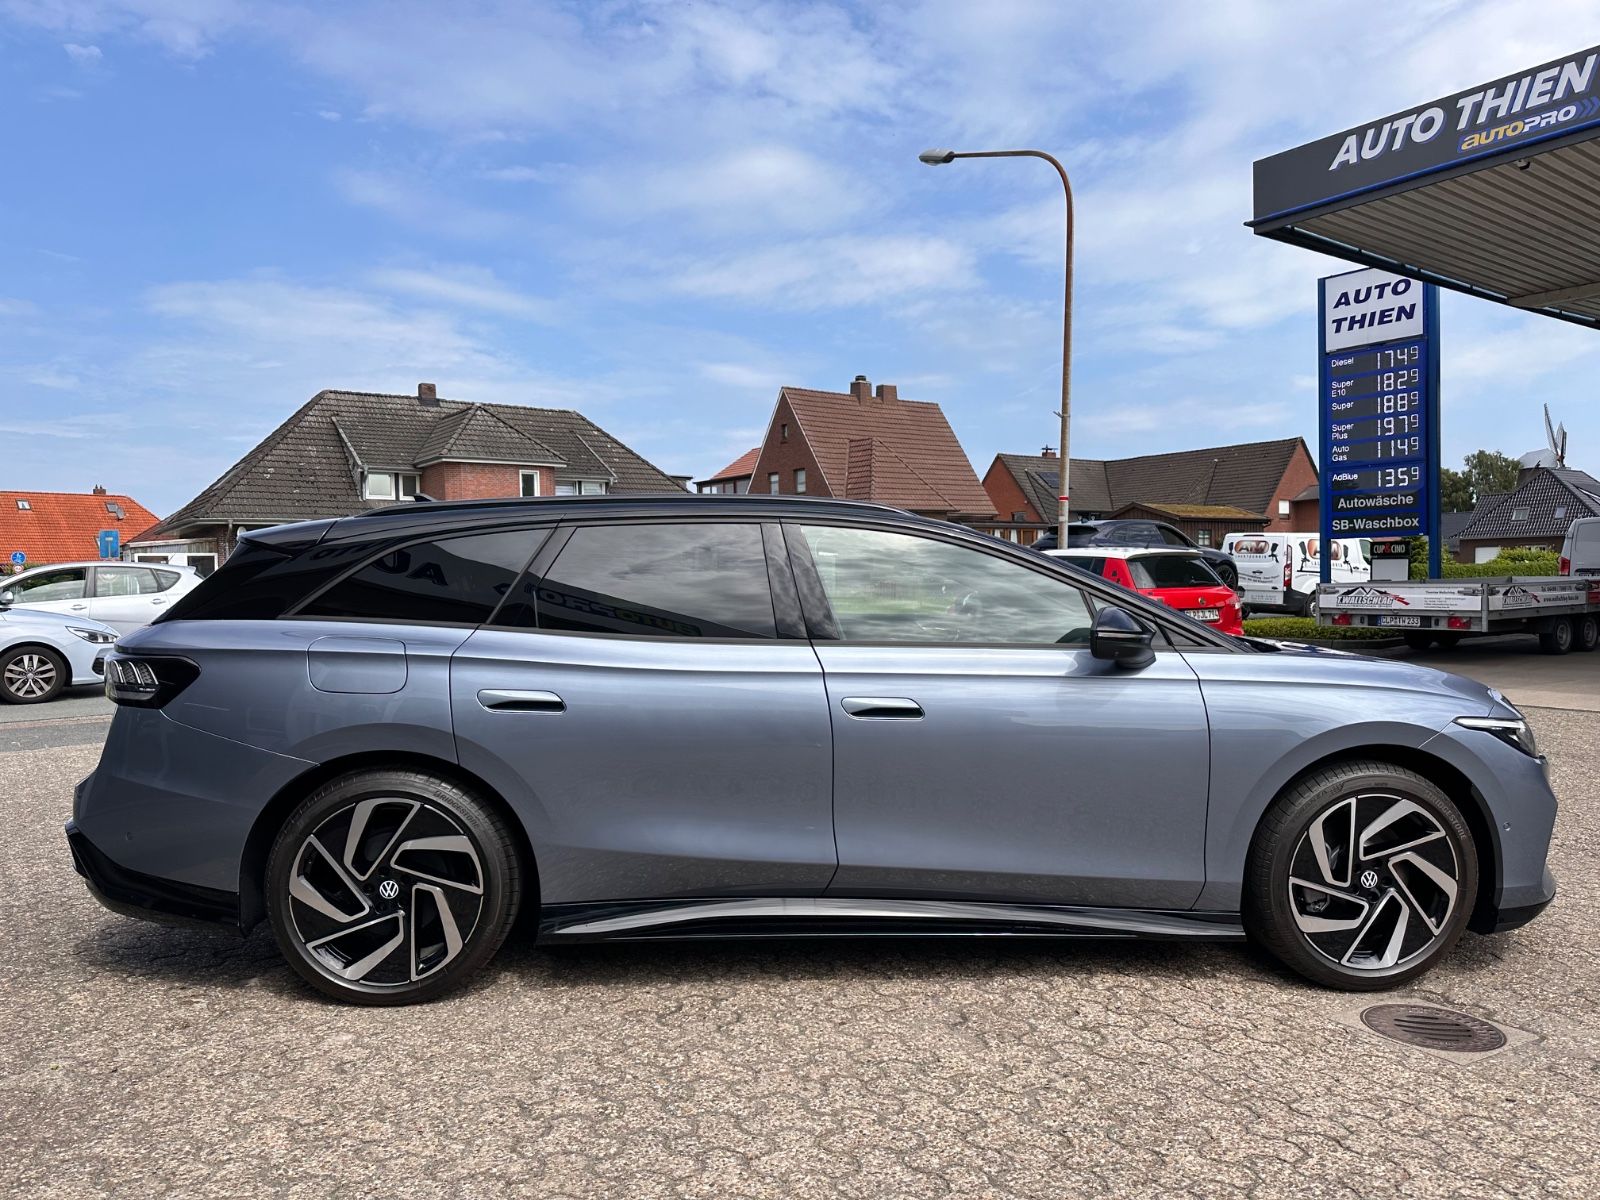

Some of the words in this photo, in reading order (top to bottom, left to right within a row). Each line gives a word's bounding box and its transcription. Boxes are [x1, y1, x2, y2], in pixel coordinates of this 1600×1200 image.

[1328, 106, 1446, 171] AUTO
[1456, 53, 1598, 131] THIEN
[1333, 278, 1411, 309] AUTO
[1331, 303, 1416, 333] THIEN
[1331, 357, 1354, 367] Diesel
[1377, 346, 1418, 369] 1749
[1331, 380, 1354, 390] Super
[1377, 368, 1418, 391] 1829
[1331, 389, 1346, 397] E10
[1331, 402, 1354, 411] Super
[1377, 391, 1418, 413] 1889
[1331, 423, 1354, 432] Super
[1377, 414, 1418, 436] 1979
[1331, 432, 1348, 440] Plus
[1332, 473, 1358, 481] AdBlue
[1377, 467, 1419, 487] 1359
[1337, 494, 1414, 509] Autowäsche
[1332, 517, 1419, 531] SB-Waschbox
